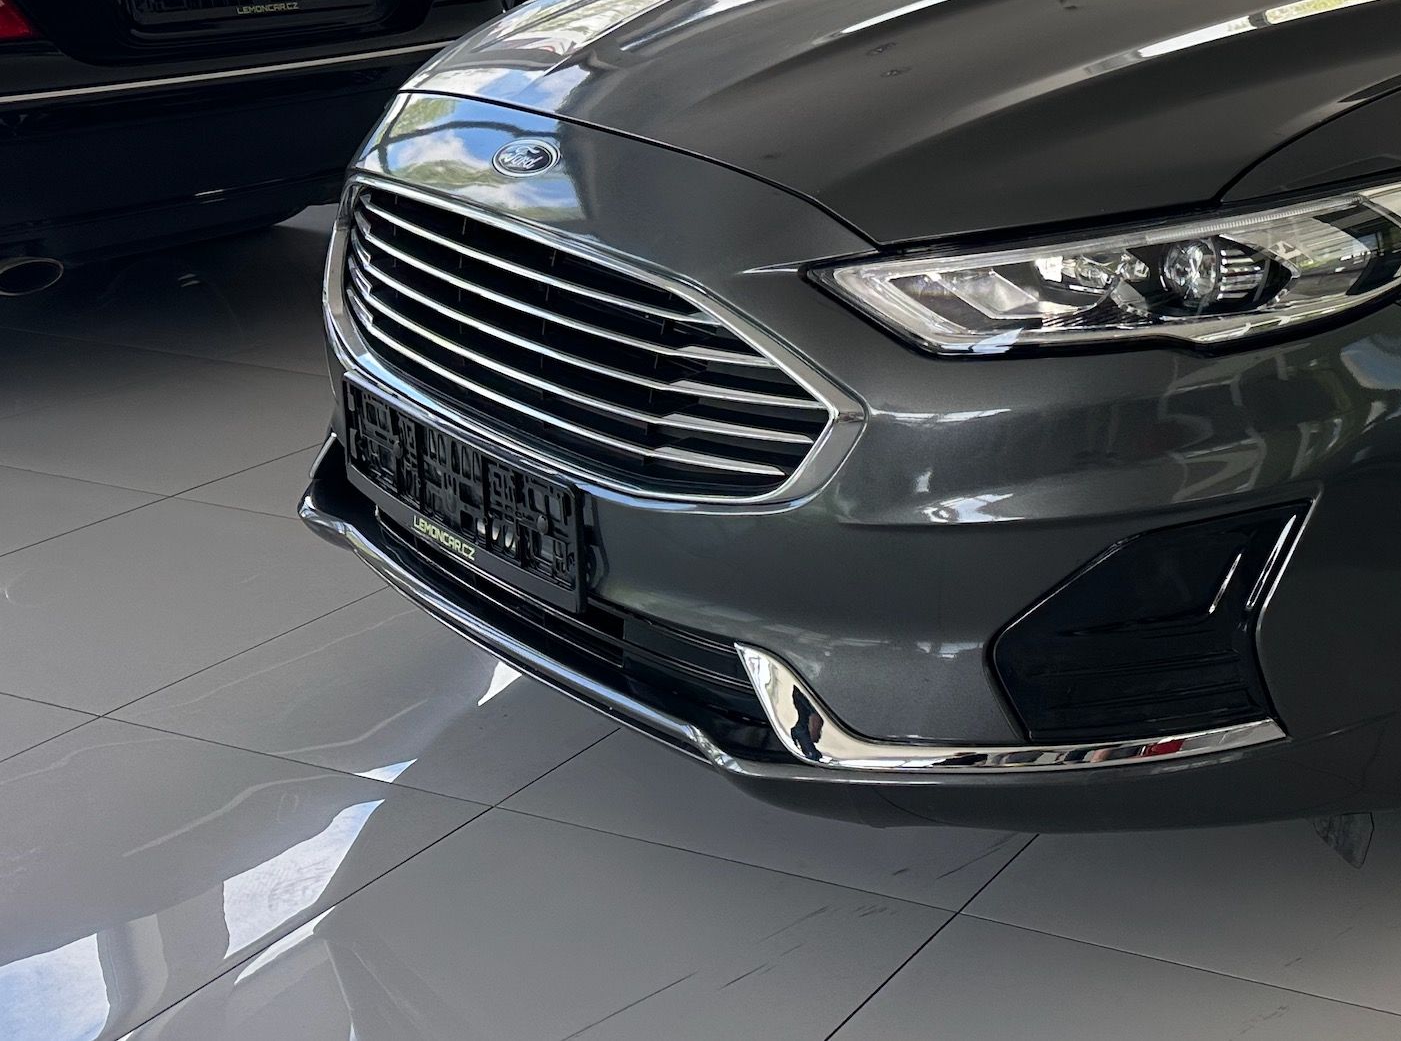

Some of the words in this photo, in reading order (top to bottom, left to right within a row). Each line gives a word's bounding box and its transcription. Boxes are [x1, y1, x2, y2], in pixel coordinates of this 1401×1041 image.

[236, 2, 299, 14] LEMONCAR.CZ
[504, 146, 543, 169] Ford
[413, 515, 475, 561] LEMONCAR.CZ
